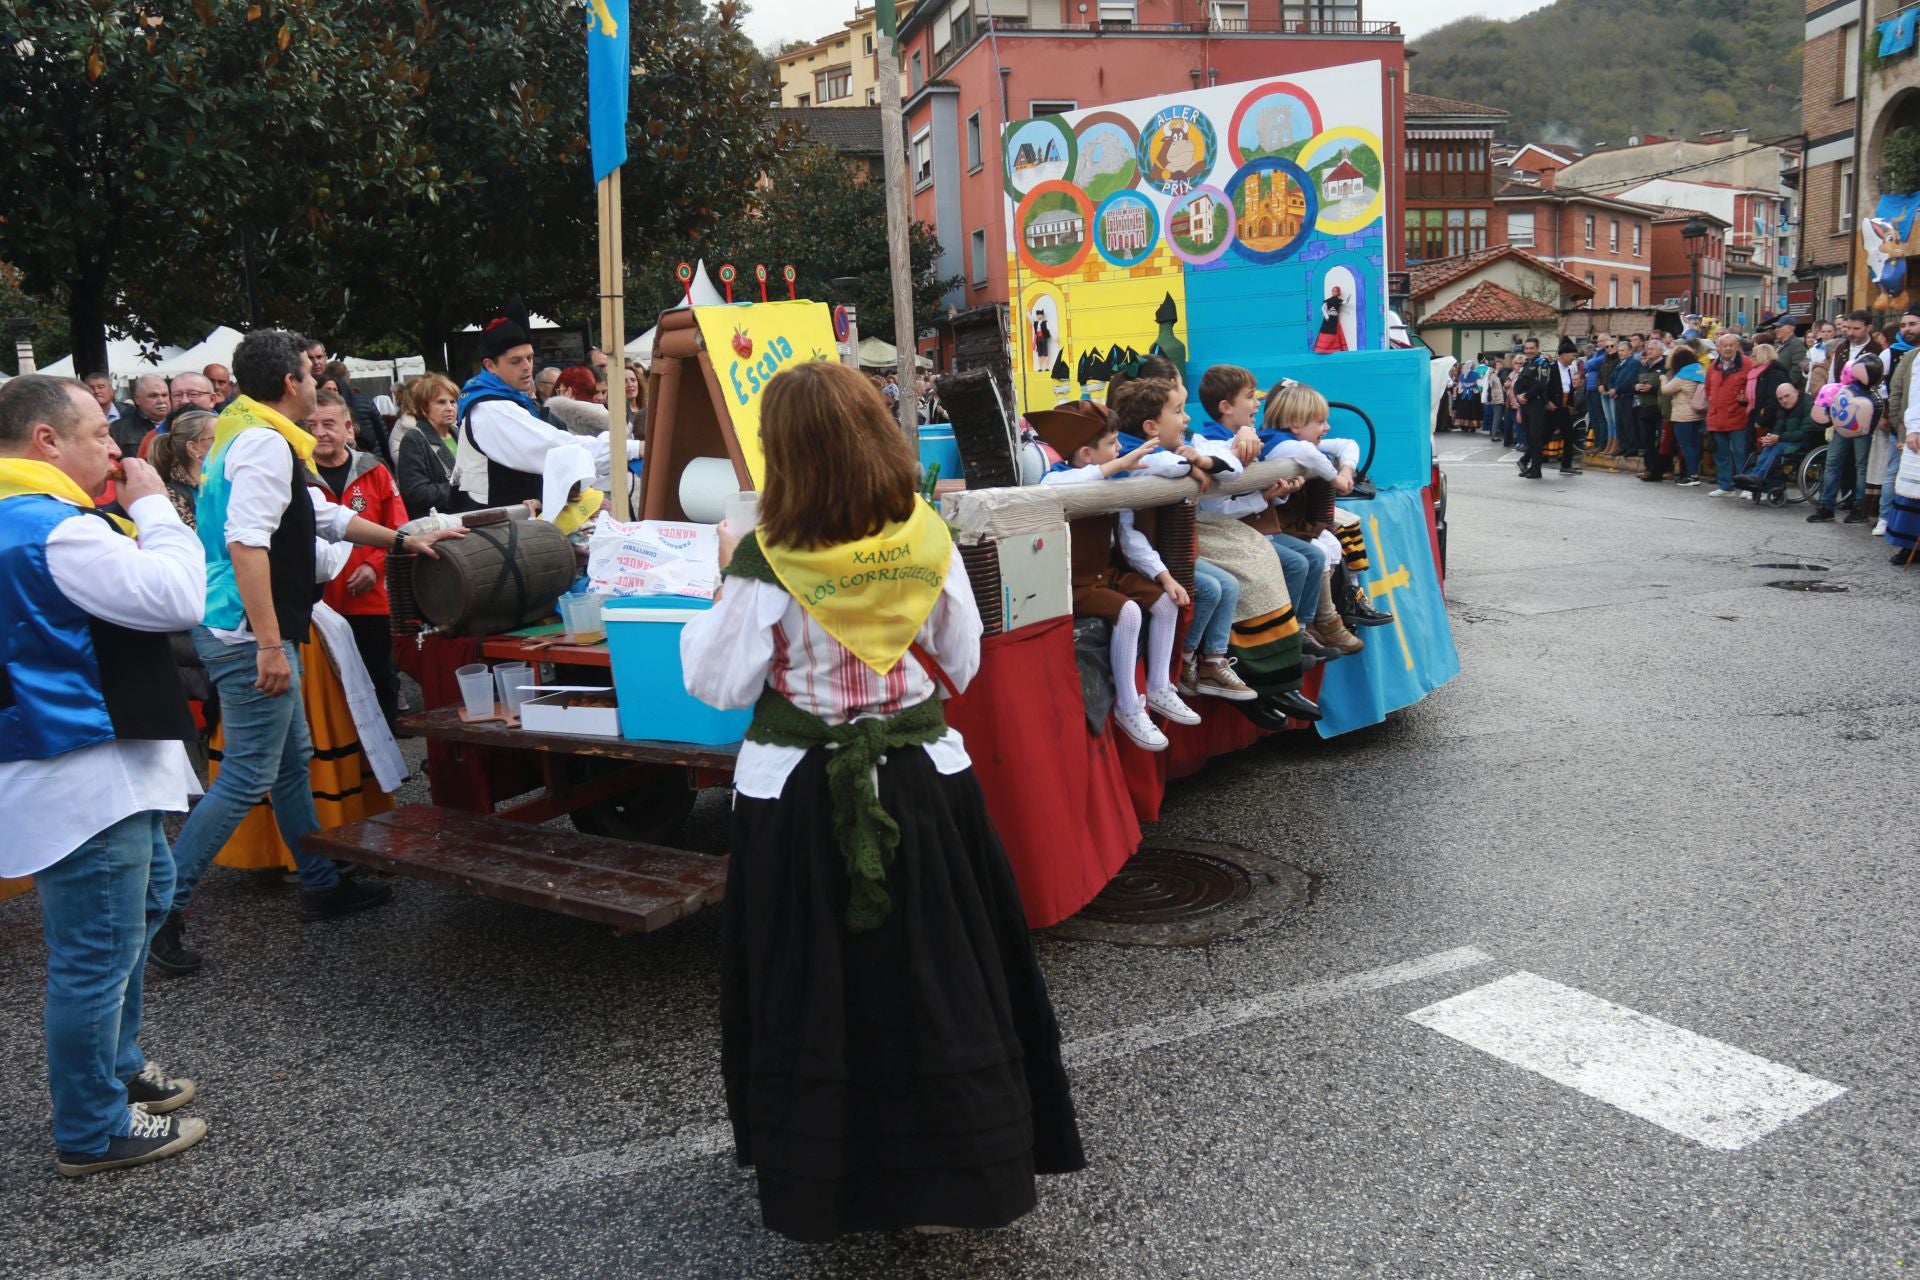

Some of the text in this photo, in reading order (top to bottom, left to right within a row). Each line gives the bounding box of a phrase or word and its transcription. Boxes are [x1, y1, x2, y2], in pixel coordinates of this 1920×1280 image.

[1157, 107, 1200, 127] ALLER
[1162, 177, 1193, 196] PRIX
[729, 335, 793, 405] Escala
[657, 527, 697, 539] MANUEL
[852, 543, 911, 564] XANDA
[804, 580, 836, 606] LOS
